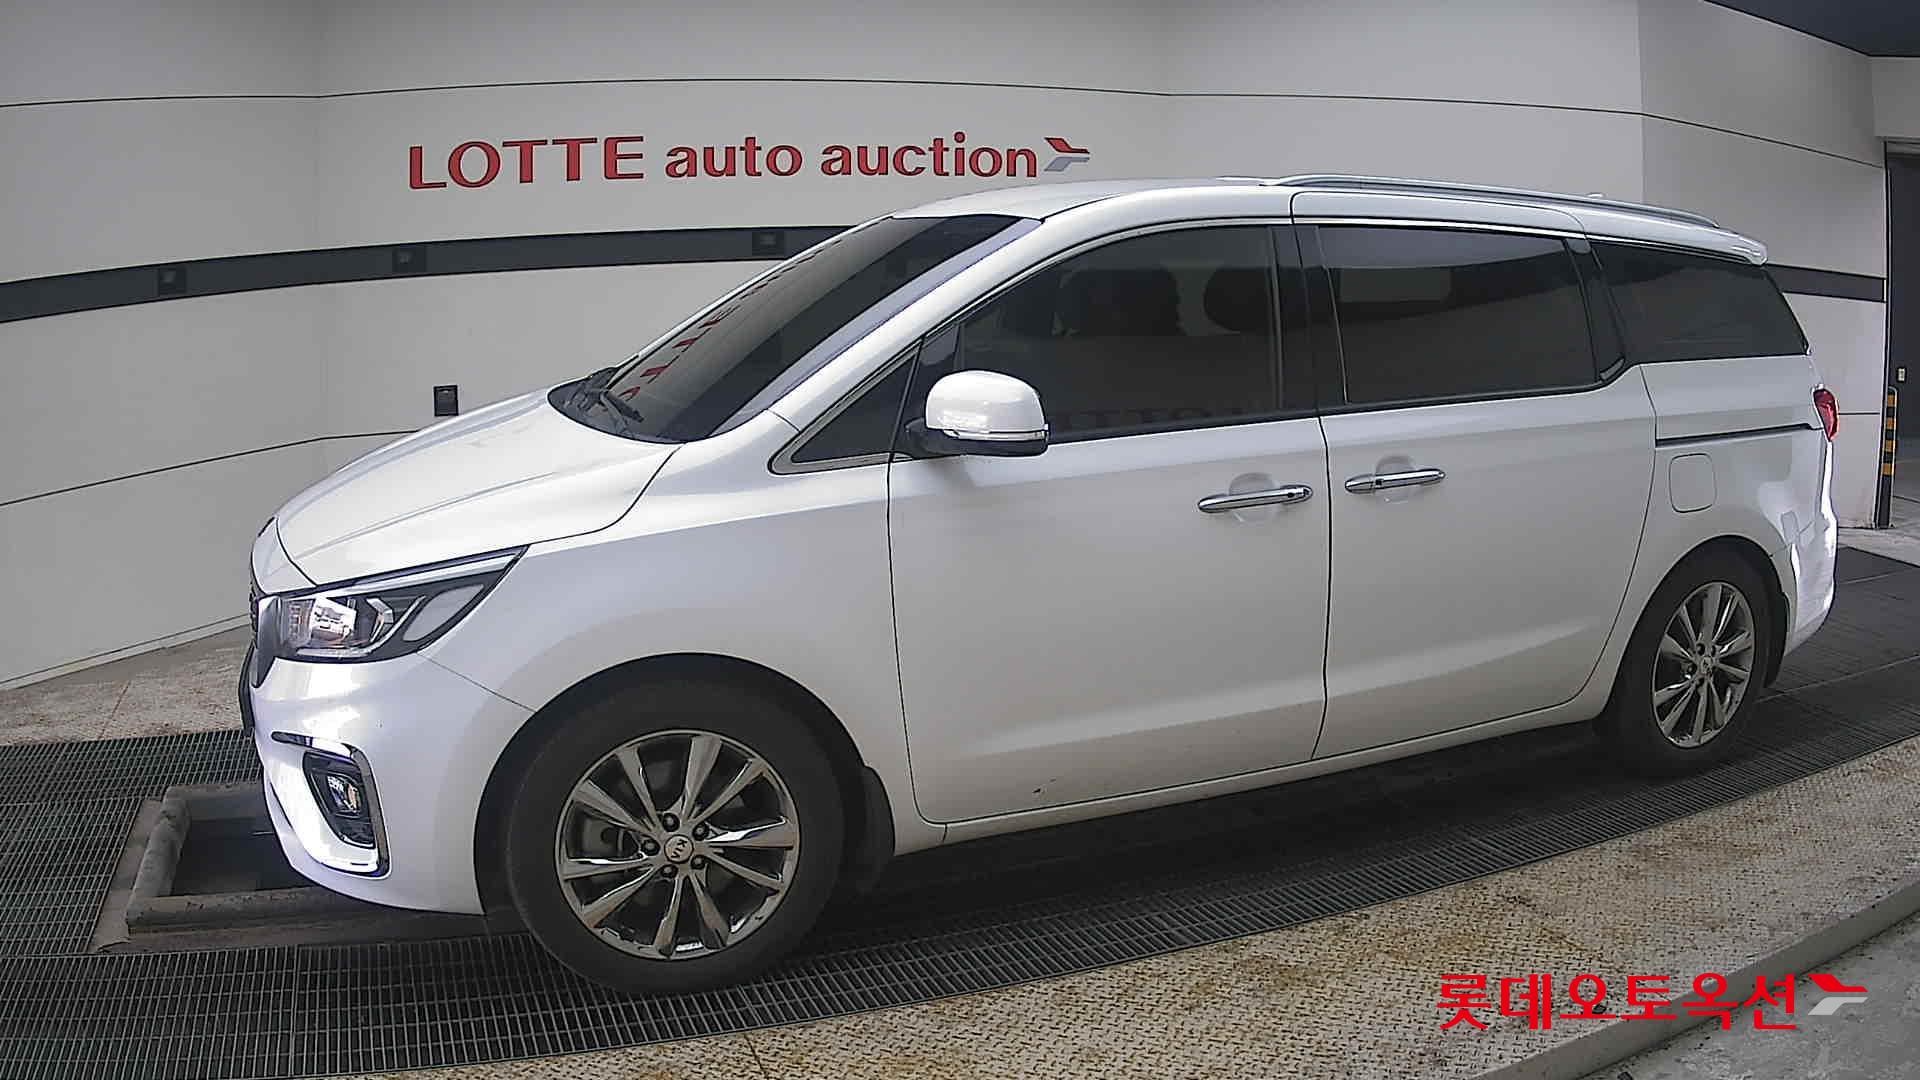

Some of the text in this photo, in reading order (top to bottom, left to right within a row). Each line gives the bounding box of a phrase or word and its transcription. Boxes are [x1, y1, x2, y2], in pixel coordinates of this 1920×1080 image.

[409, 131, 1037, 189] LOTTE auto auction
